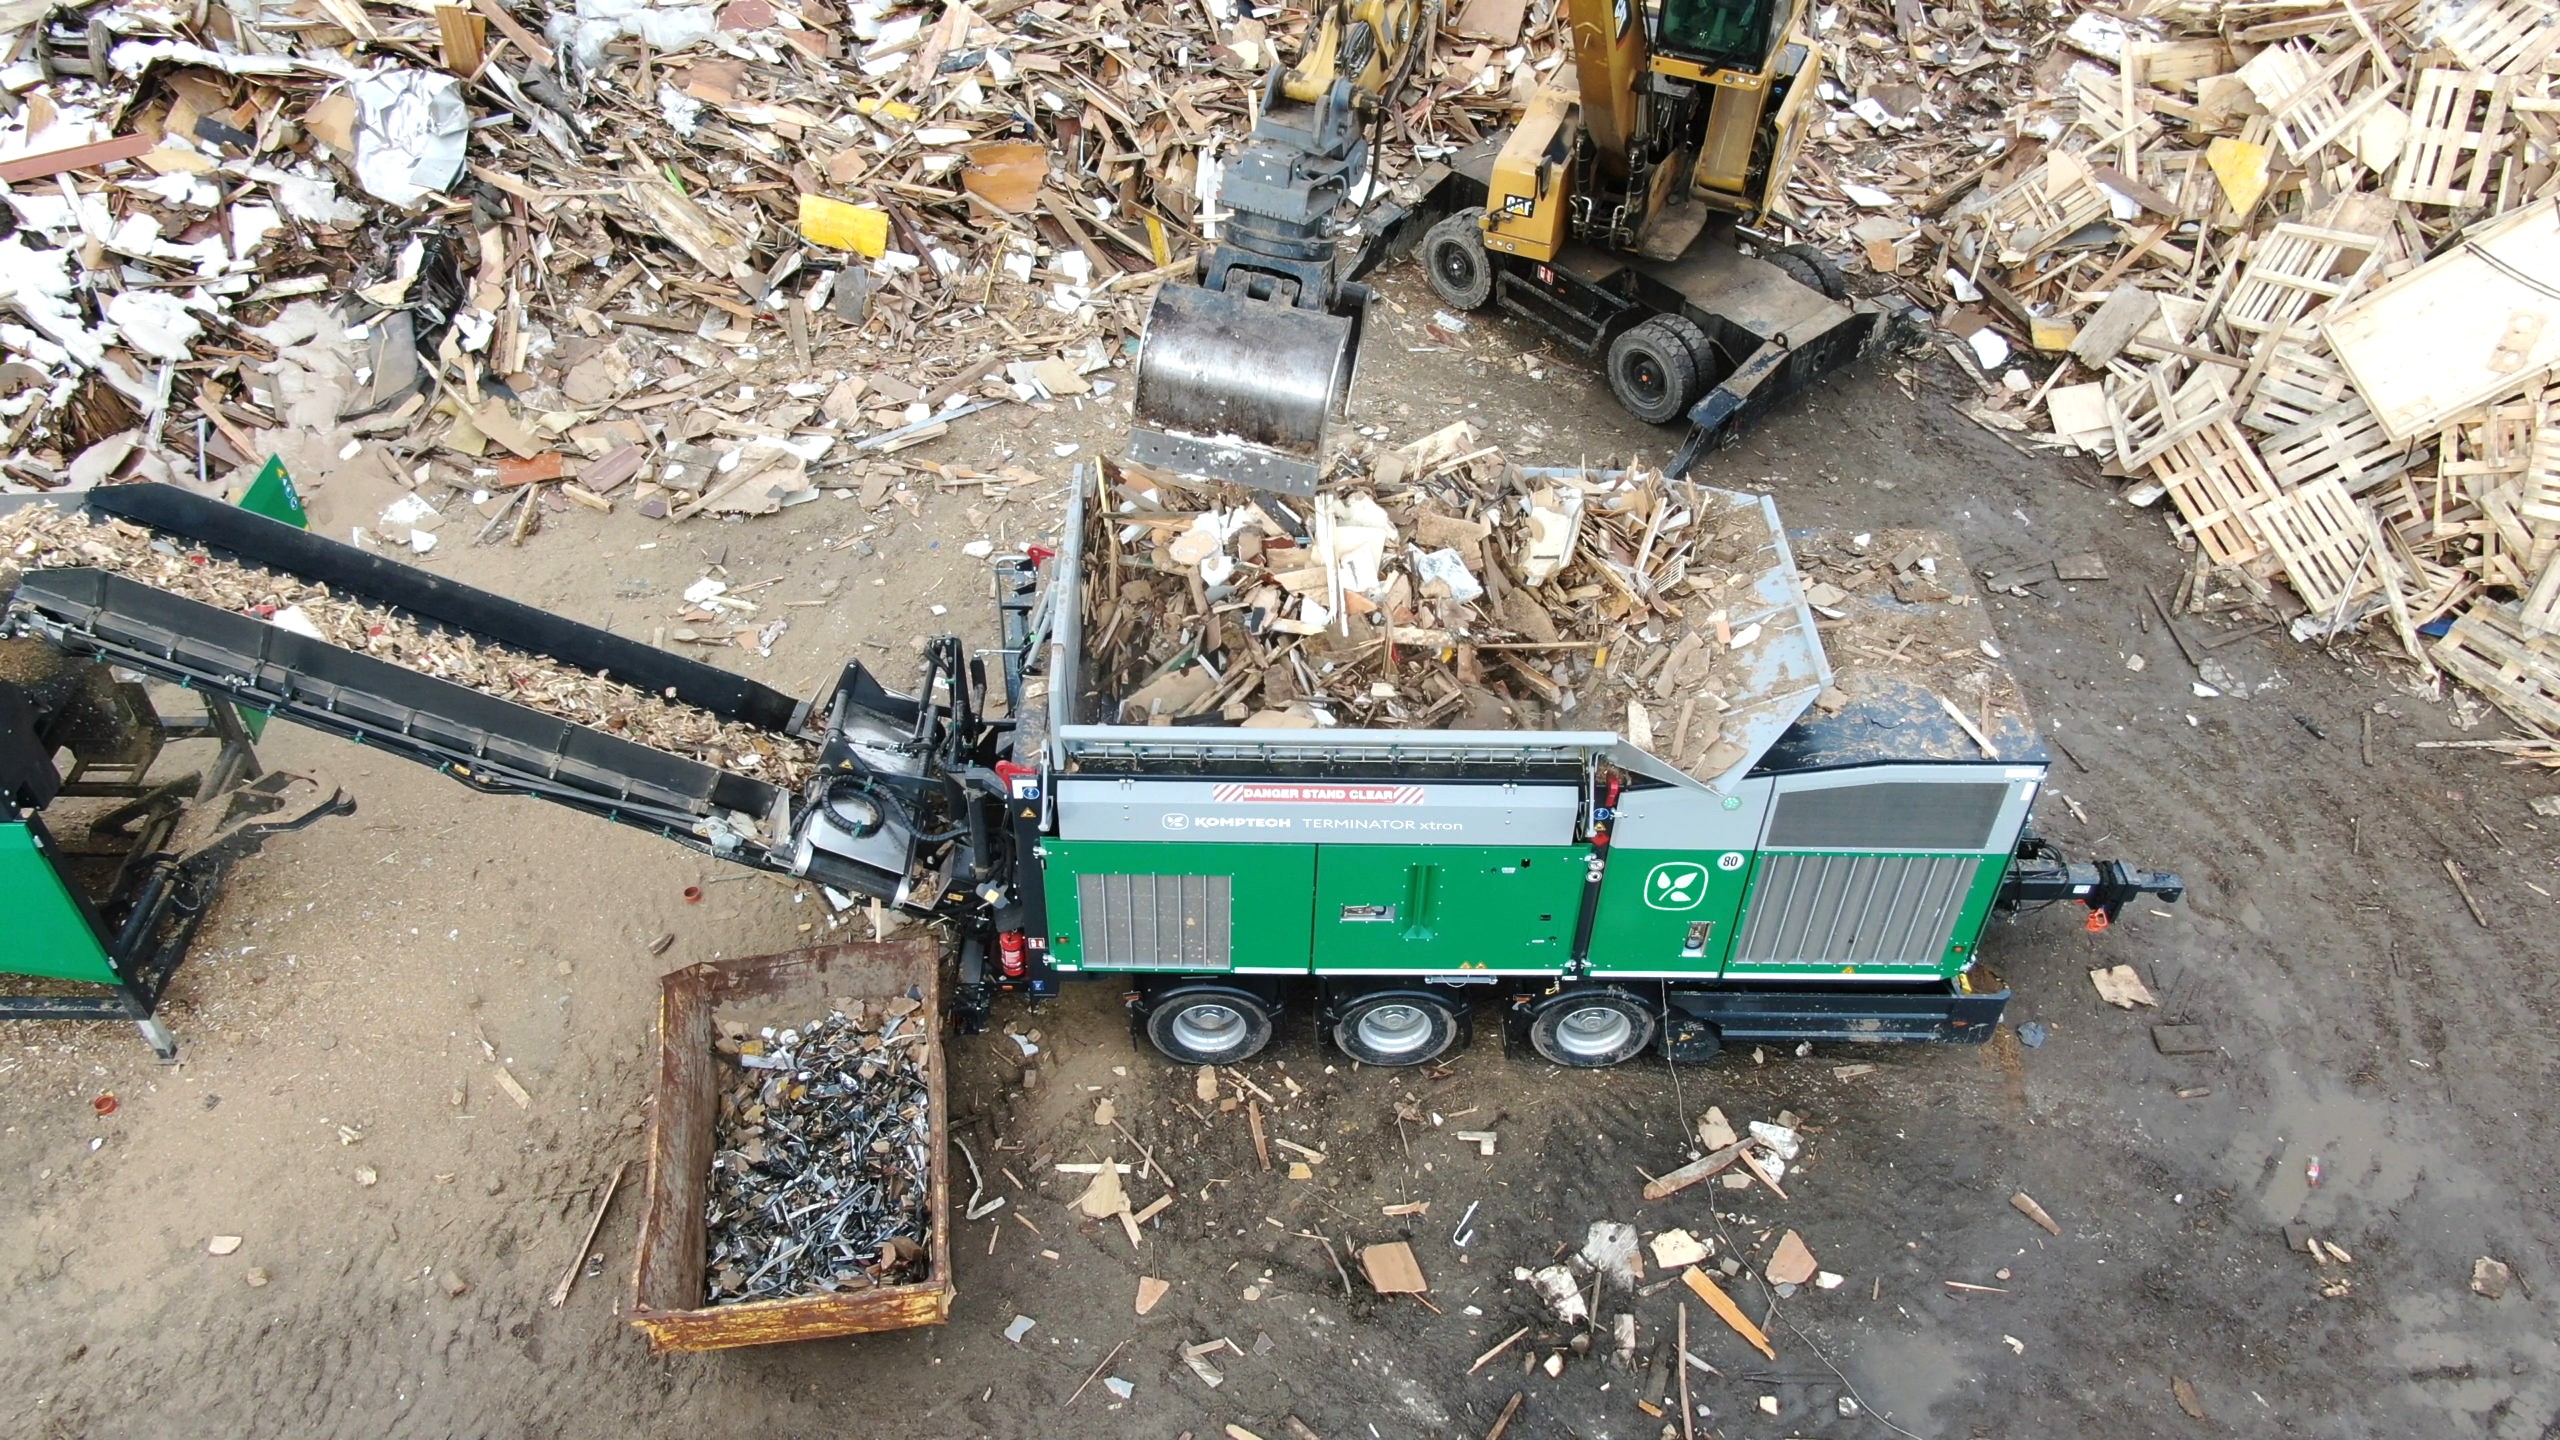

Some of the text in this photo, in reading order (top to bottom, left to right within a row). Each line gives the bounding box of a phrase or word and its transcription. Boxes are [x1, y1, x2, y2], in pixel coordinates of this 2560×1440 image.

[1506, 196, 1532, 216] CAT
[1243, 788, 1393, 800] DANGER STAND CLEAR
[1194, 817, 1463, 831] KOMPTECH TERMINATOR xtron
[1723, 855, 1739, 867] 80
